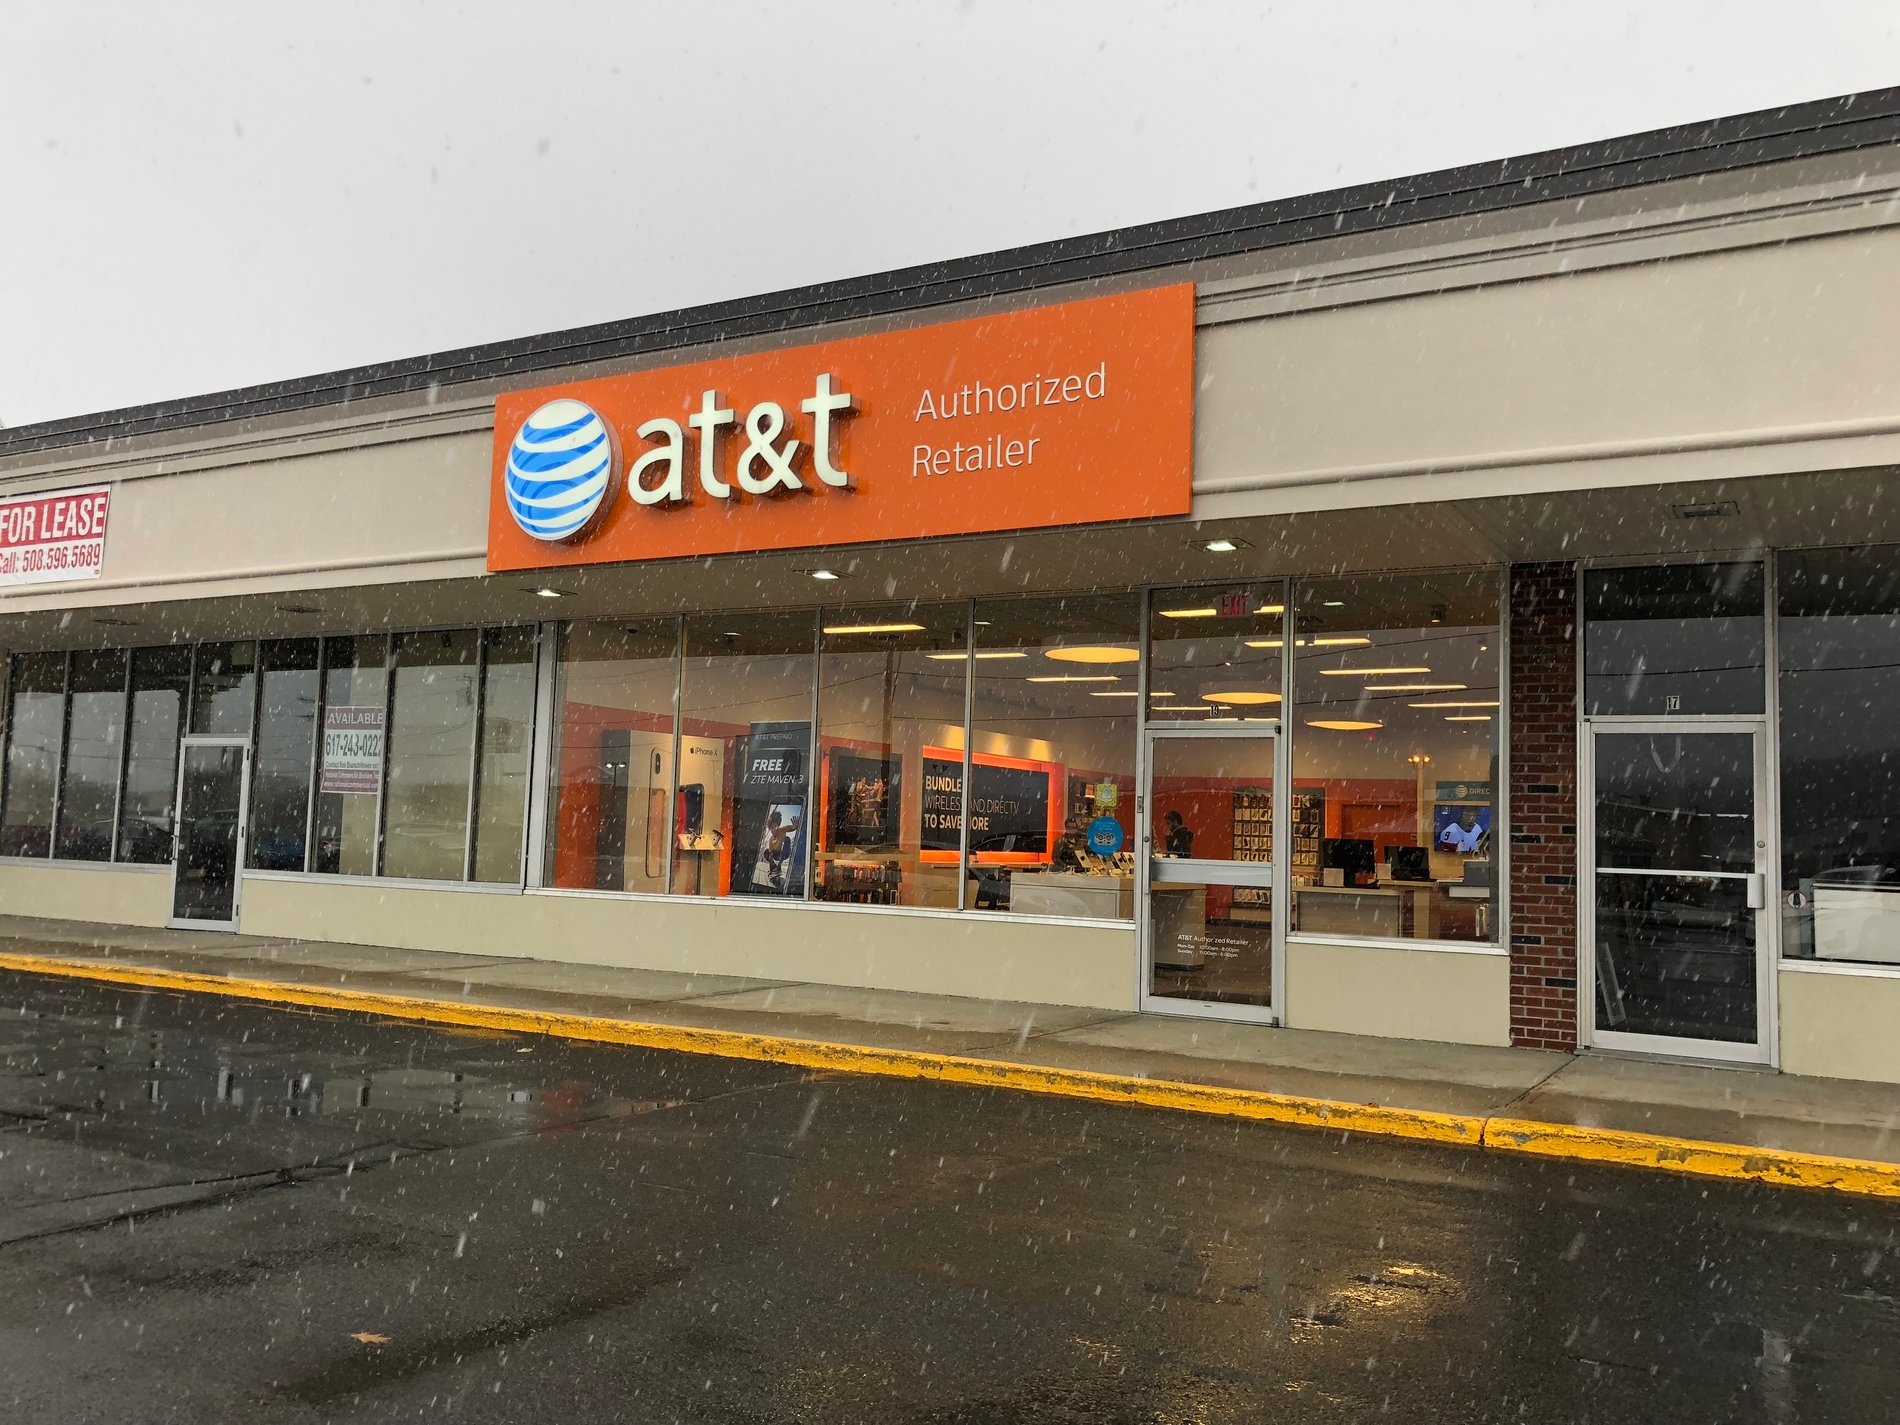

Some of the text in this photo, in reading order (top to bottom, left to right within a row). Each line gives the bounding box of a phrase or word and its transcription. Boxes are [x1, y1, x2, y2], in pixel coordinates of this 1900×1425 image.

[915, 361, 1105, 422] Authorized
[627, 372, 852, 505] at&t
[912, 434, 1041, 477] Retailer
[0, 497, 106, 544] FOR LEASE
[22, 543, 101, 573] 508.596.5689
[1221, 594, 1248, 616] EXIT
[1209, 703, 1220, 716] 19
[1667, 696, 1679, 709] 17
[328, 713, 383, 725] AVAILABLE
[694, 747, 713, 756] iPhone
[752, 759, 784, 771] FREE
[750, 774, 804, 784] ZTE MAVEN 3
[925, 775, 962, 793] BUNDLE
[924, 794, 964, 811] WIRELES
[924, 813, 938, 829] TO
[939, 814, 962, 830] SAVE
[1193, 935, 1226, 944] Authorzed
[1226, 938, 1249, 946] Retailer
